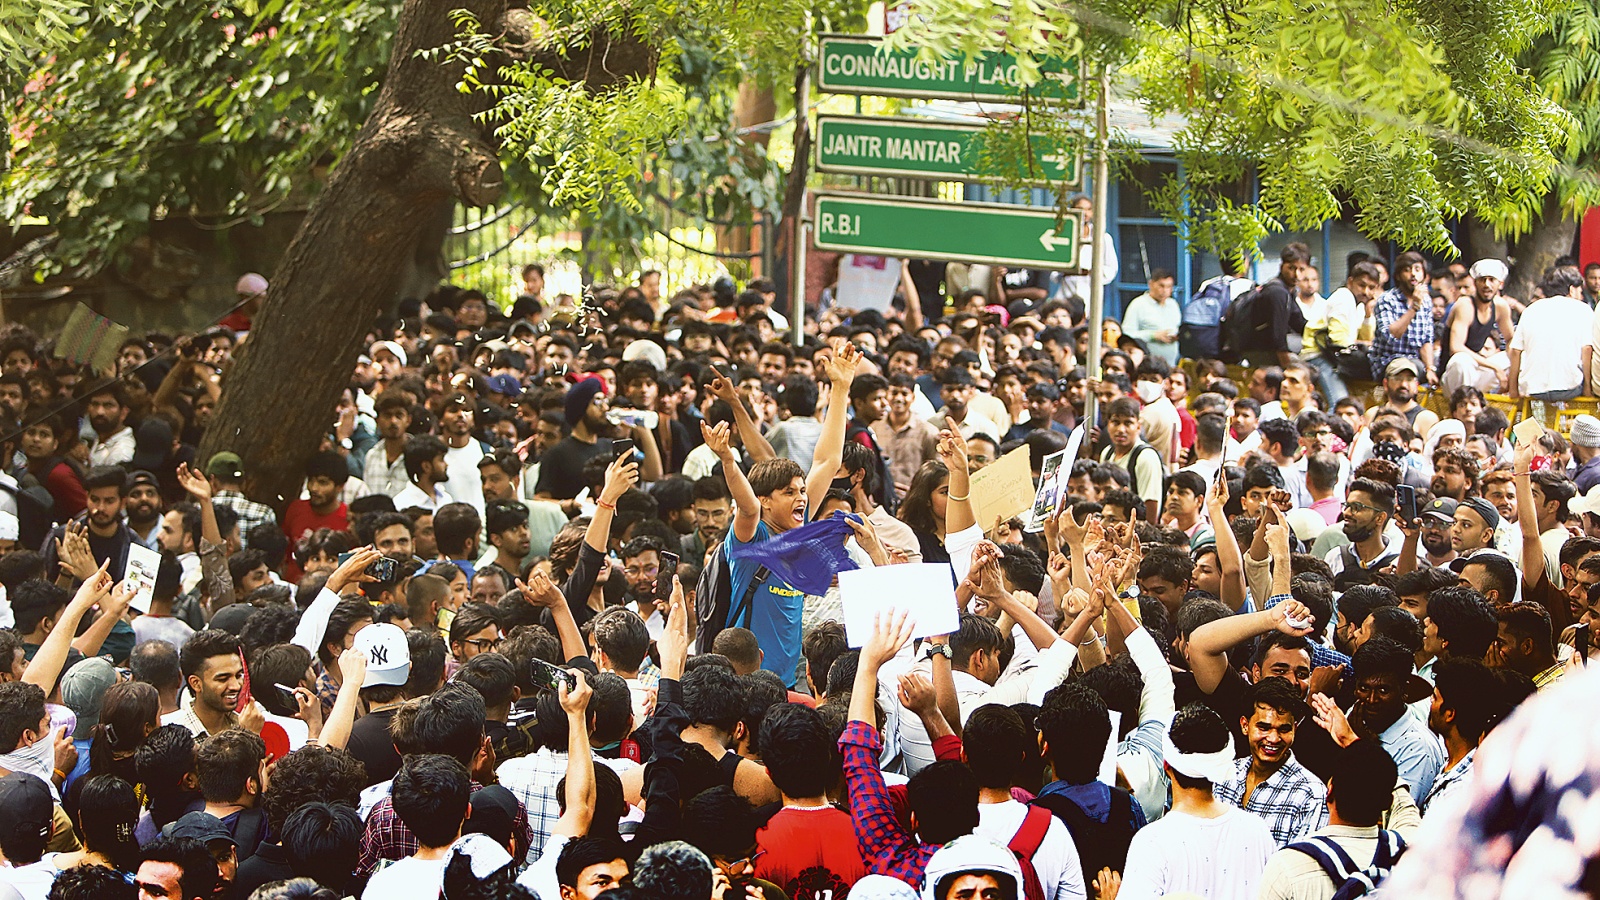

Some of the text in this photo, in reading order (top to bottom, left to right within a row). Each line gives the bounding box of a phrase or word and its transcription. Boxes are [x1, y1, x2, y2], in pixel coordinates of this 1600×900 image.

[825, 53, 1034, 88] CONNAUGHT PLAC
[823, 133, 961, 164] JANTR MANTAR
[821, 212, 861, 236] R.B.I
